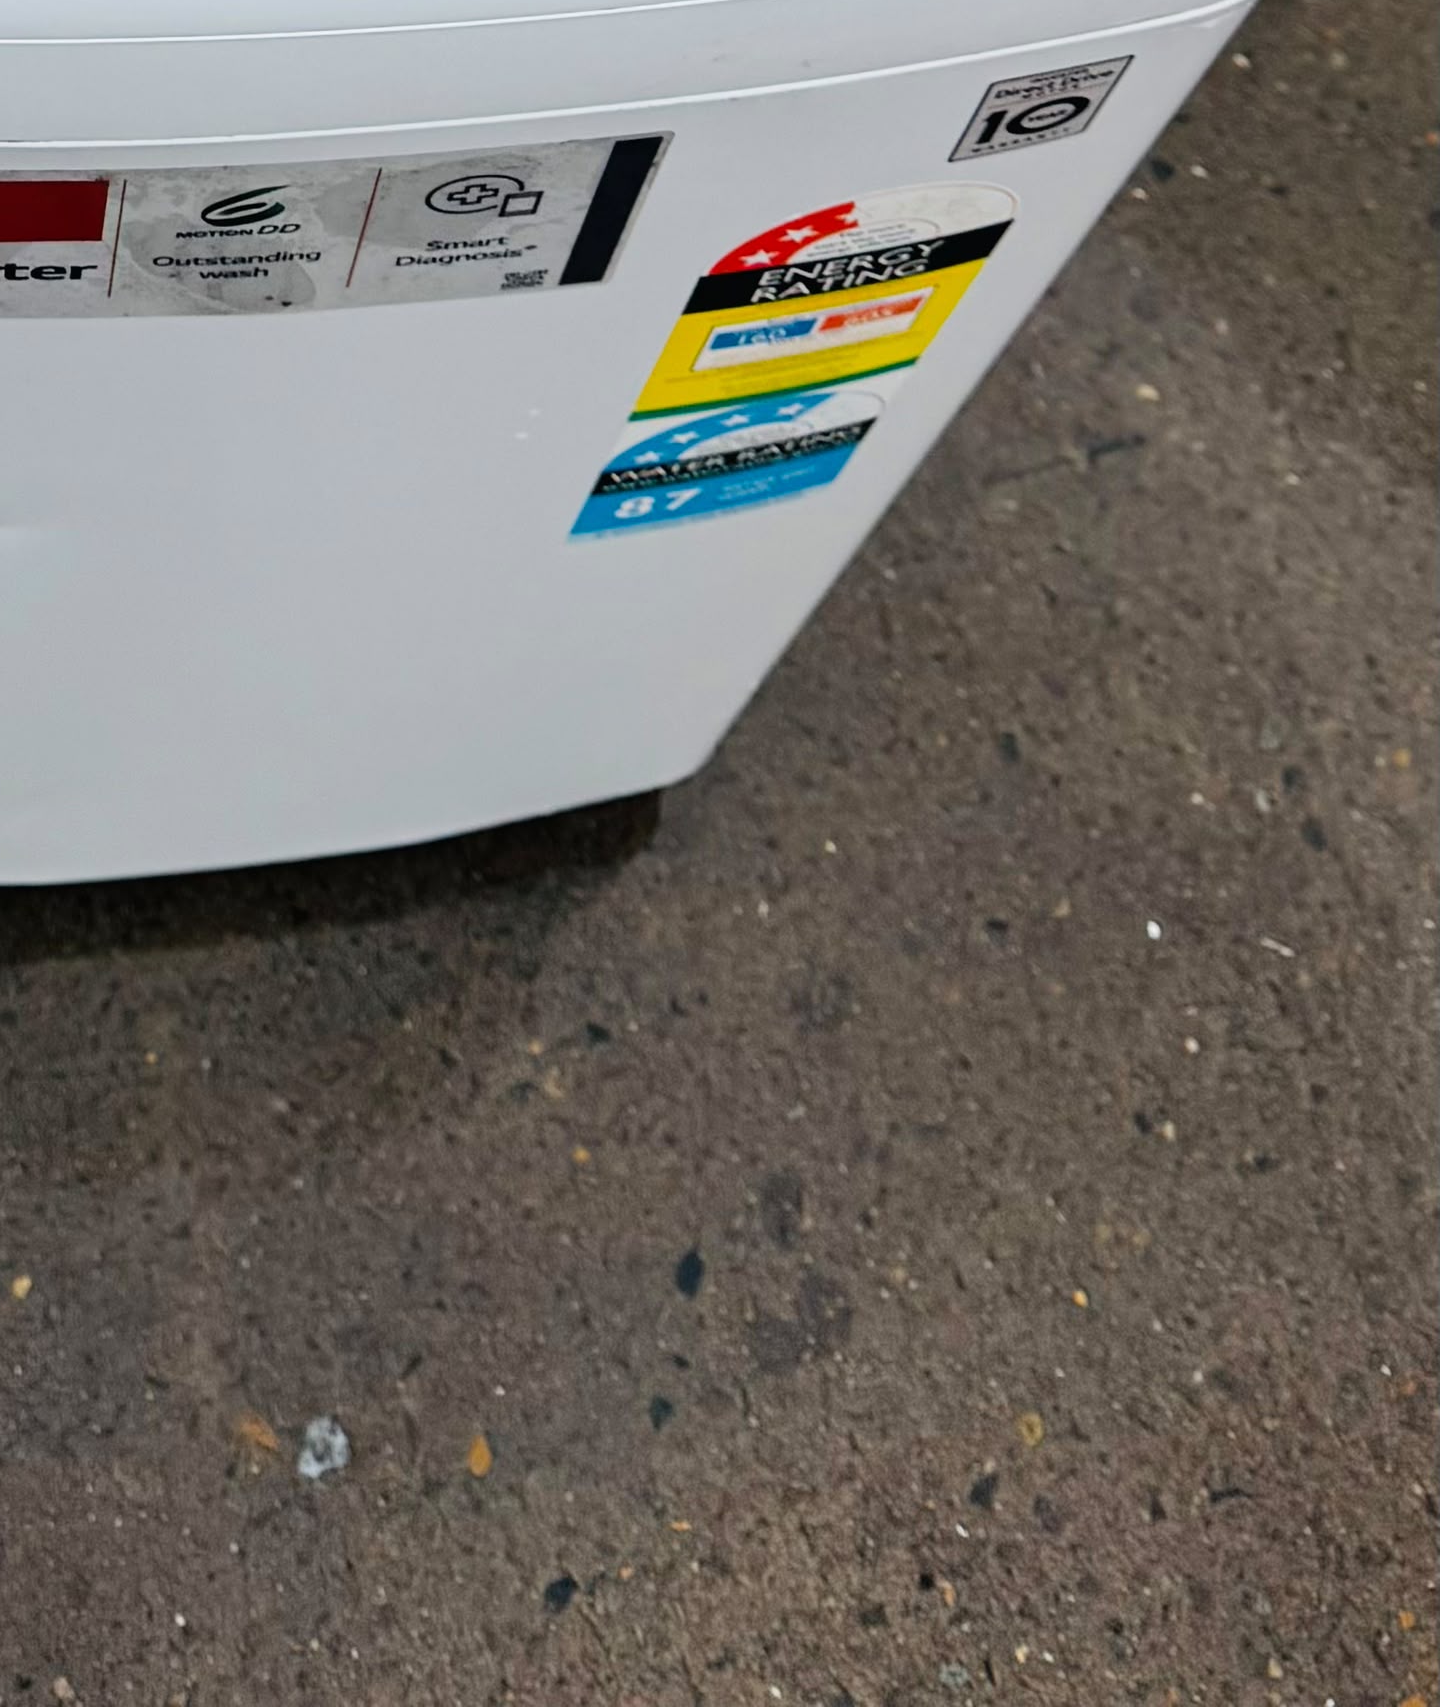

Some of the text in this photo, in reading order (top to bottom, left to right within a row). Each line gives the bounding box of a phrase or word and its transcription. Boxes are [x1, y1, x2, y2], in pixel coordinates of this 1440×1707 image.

[974, 96, 1091, 145] 10
[175, 223, 302, 239] MOTION DD
[425, 237, 510, 251] Smart
[152, 250, 322, 267] Outstanding
[758, 239, 945, 286] ENERGY
[199, 267, 270, 279] wash
[750, 258, 930, 303] RATING
